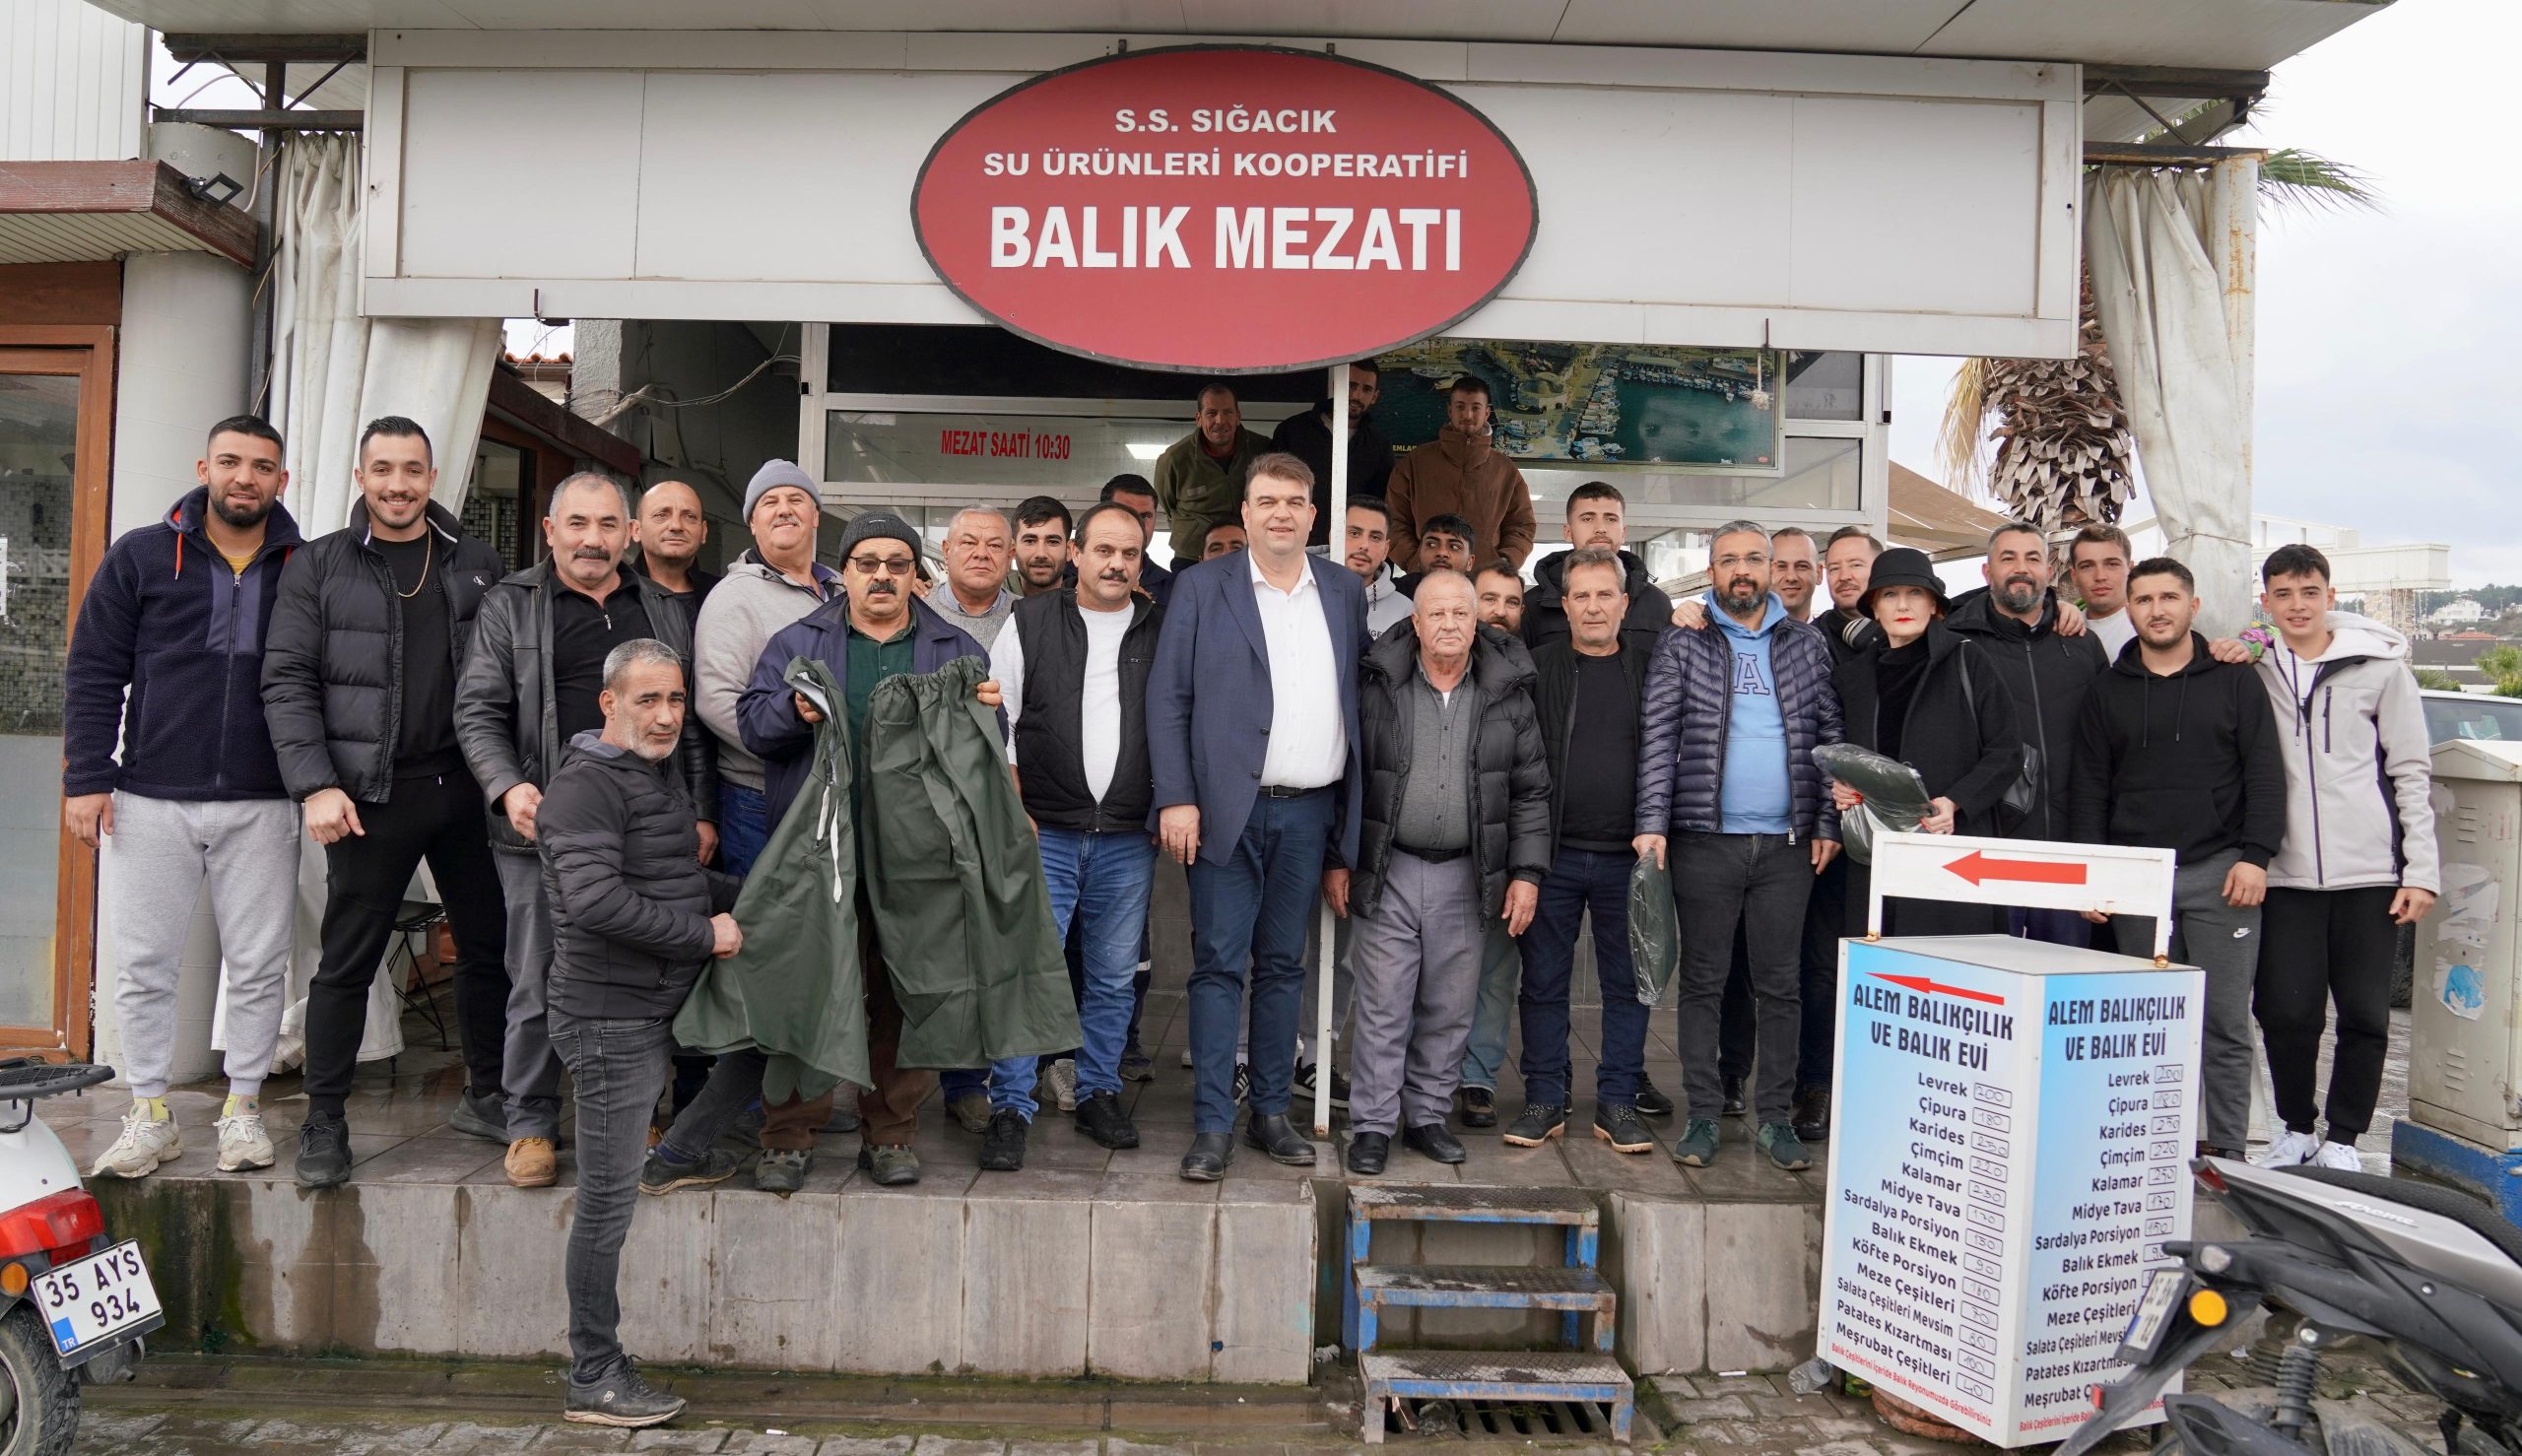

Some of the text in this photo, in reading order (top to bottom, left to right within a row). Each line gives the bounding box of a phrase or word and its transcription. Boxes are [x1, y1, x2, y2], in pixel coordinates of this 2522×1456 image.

[1115, 103, 1337, 133] S.S. SIĞACIK
[983, 147, 1468, 178] SU ÜRÜNLERİ KOOPERATİFİ
[990, 205, 1461, 271] BALIK MEZATI
[941, 427, 1071, 460] MEZAT SAATİ 10:30
[1733, 653, 1770, 695] A
[1853, 984, 2014, 1041] ALEM BALIKÇILIK
[2048, 996, 2186, 1026] ALEM BALIKÇILIK
[1897, 1027, 1951, 1063] BALIK
[2091, 1033, 2137, 1059] BALIK
[1918, 1072, 1967, 1097] Levrek
[2108, 1070, 2150, 1087] Levrek
[1919, 1096, 1966, 1121] Çipura
[2108, 1096, 2148, 1116] Çipura
[1909, 1117, 1964, 1146] Karides
[2099, 1122, 2147, 1140] Karides
[1910, 1142, 1963, 1170] Çimçim
[2100, 1147, 2145, 1169] Çimçim
[1901, 1162, 1962, 1193] Kalamar
[2091, 1175, 2143, 1192] Kalamar
[1881, 1179, 1922, 1205] Midye
[1927, 1195, 1960, 1218] Tava
[2072, 1204, 2110, 1221] Midye
[2114, 1201, 2142, 1216] Tava
[1844, 1189, 1897, 1219] Sardalya
[1901, 1209, 1959, 1242] Porsiyon
[1872, 1222, 1905, 1246] Balık
[1909, 1237, 1958, 1266] Ekmek
[2035, 1231, 2088, 1250] Sardalya
[2090, 1225, 2140, 1244] Porsiyon
[1852, 1237, 1890, 1263] Köfte
[1893, 1254, 1957, 1291] Porsiyon
[2062, 1255, 2094, 1273] Balık
[2097, 1249, 2139, 1269] Ekmek
[45, 1250, 140, 1307] 35 AYS
[1857, 1263, 1892, 1287] Meze
[1894, 1279, 1955, 1313] Çeşitleri
[2042, 1277, 2137, 1302] Köfte Porsiyon
[91, 1288, 140, 1327] 934
[1837, 1277, 1867, 1300] Salata
[1870, 1291, 1911, 1320] Çeşitleri
[1912, 1309, 1954, 1338] Mevsim
[2047, 1299, 2136, 1327] Meze Çeşitleri
[61, 1337, 77, 1350] TR
[1837, 1299, 1881, 1329] Patates
[1885, 1320, 1952, 1361] Kızartması
[2026, 1326, 2127, 1356] Salata Çeşitleri Mevsi
[1836, 1322, 1893, 1358] Meşrubat
[1896, 1350, 1950, 1385] Çeşitleri
[2025, 1363, 2070, 1381] Patates
[2024, 1383, 2081, 1409] Meşrubat
